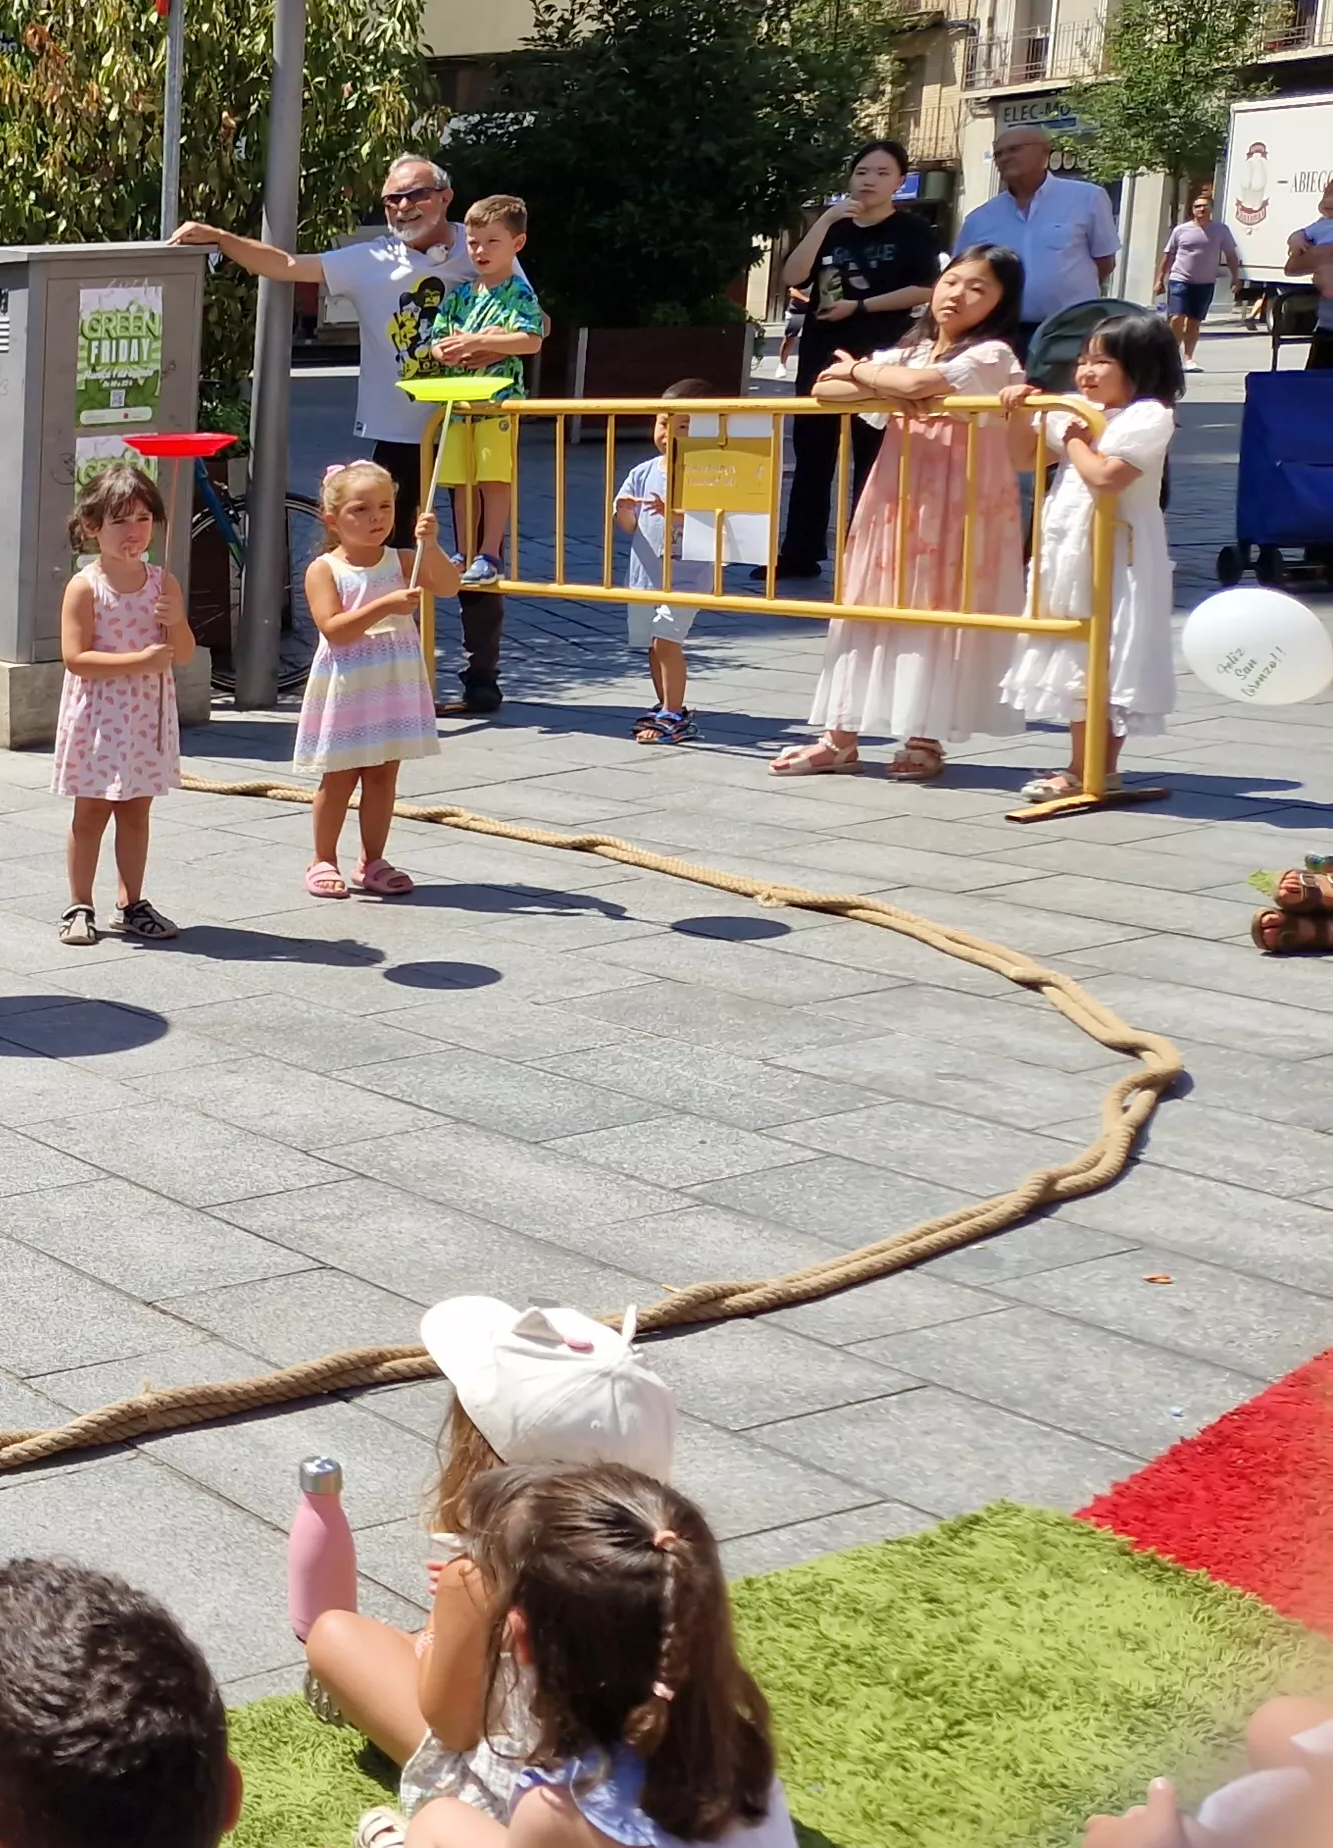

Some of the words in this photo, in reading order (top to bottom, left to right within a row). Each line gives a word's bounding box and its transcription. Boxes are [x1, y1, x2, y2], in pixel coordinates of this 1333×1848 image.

[81, 311, 160, 339] GREEN
[91, 339, 150, 363] FRIDAY
[1234, 658, 1258, 681] San
